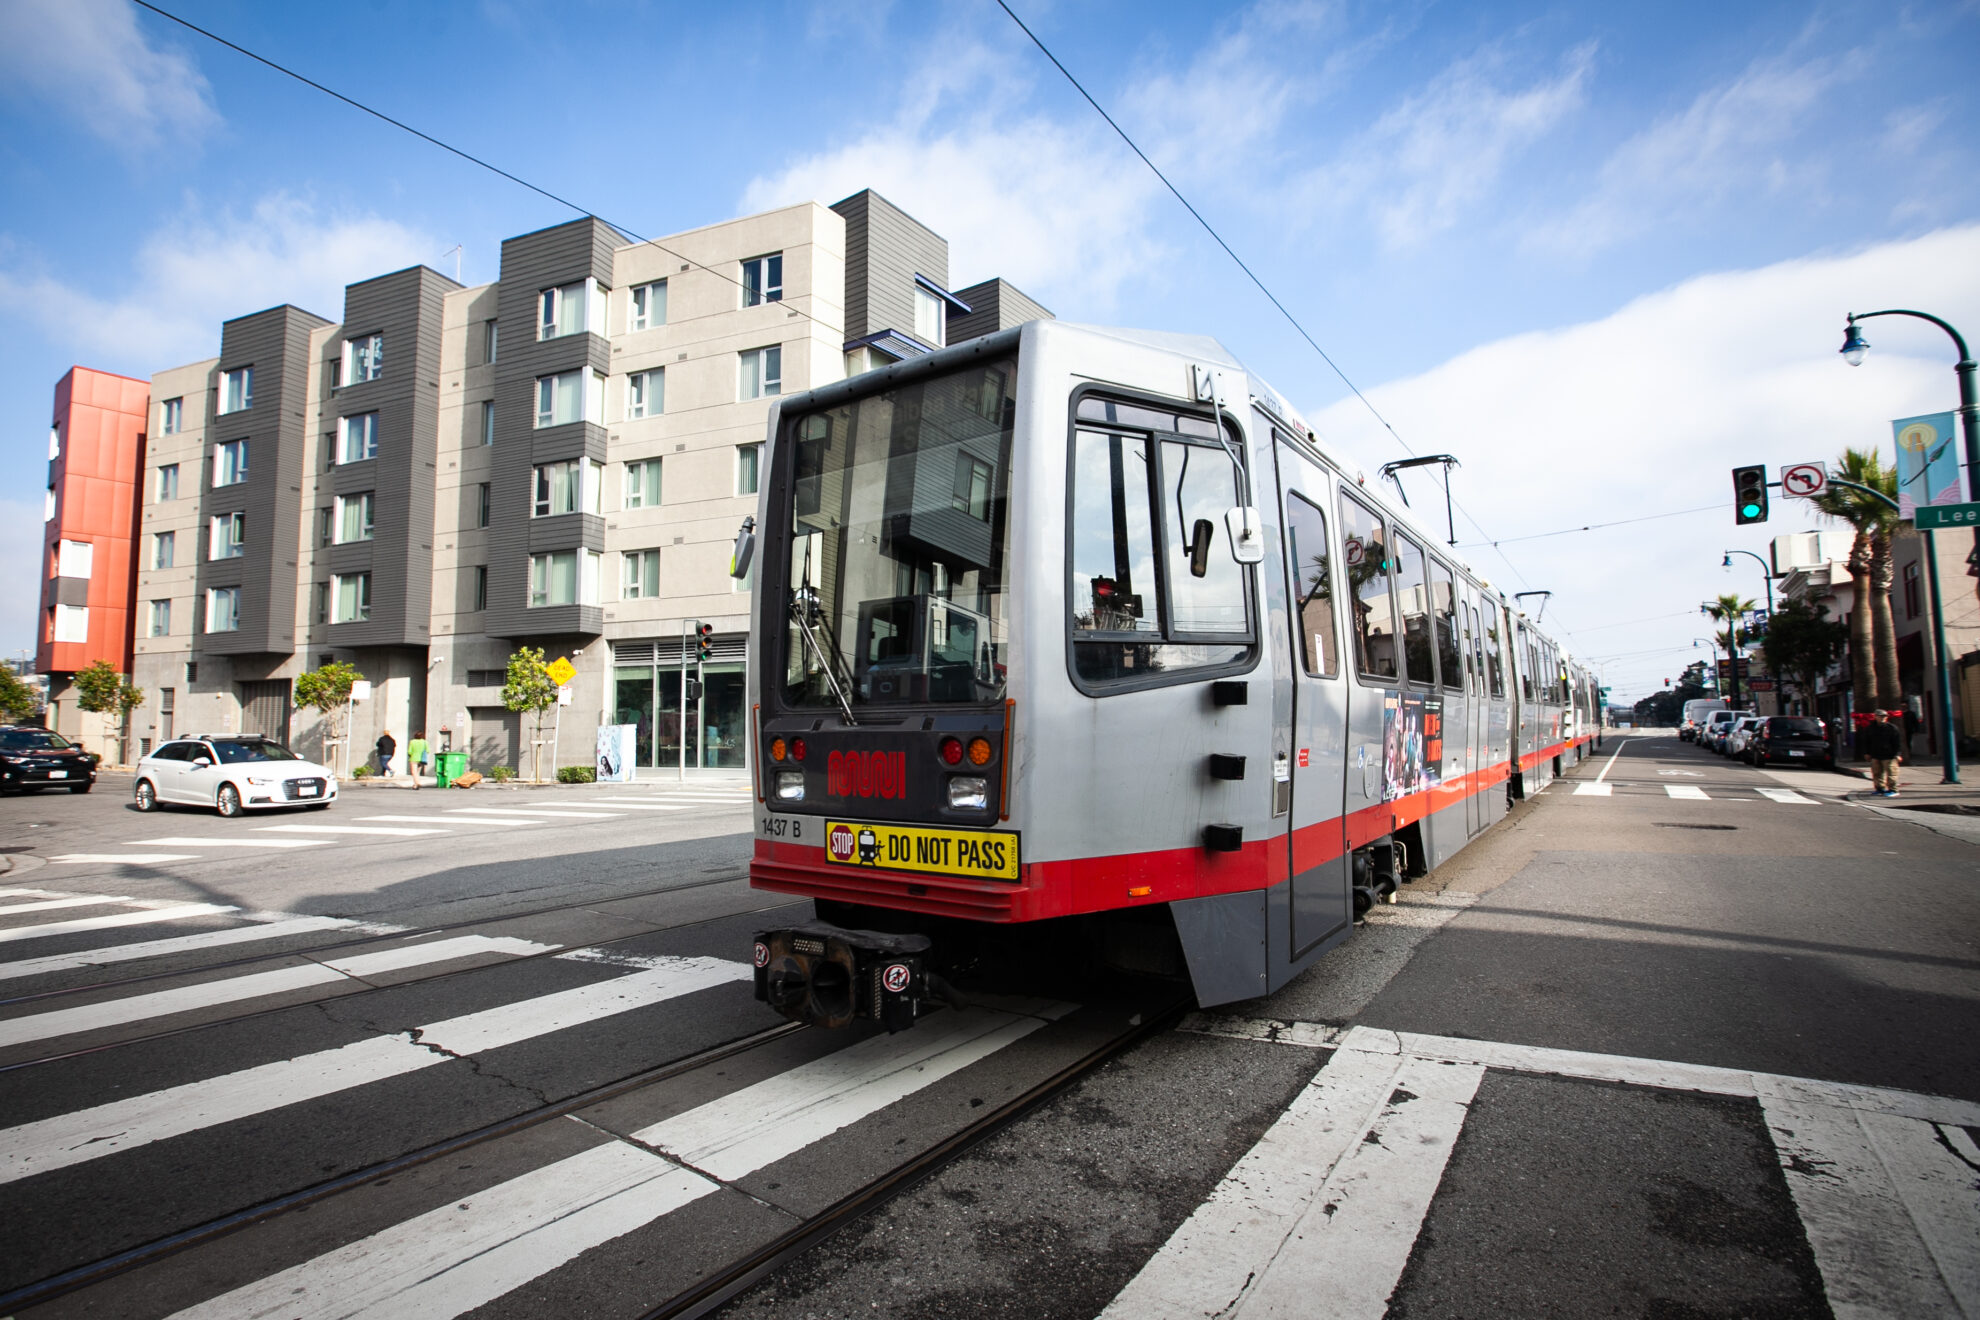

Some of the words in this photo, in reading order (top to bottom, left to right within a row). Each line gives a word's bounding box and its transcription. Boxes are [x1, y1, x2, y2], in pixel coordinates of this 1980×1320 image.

[1937, 510, 1977, 523] Lee
[762, 818, 787, 837] 1437
[793, 820, 801, 838] B
[832, 833, 854, 855] STOP
[889, 835, 911, 862] DO
[917, 837, 951, 865] NOT
[958, 840, 1005, 871] PASS
